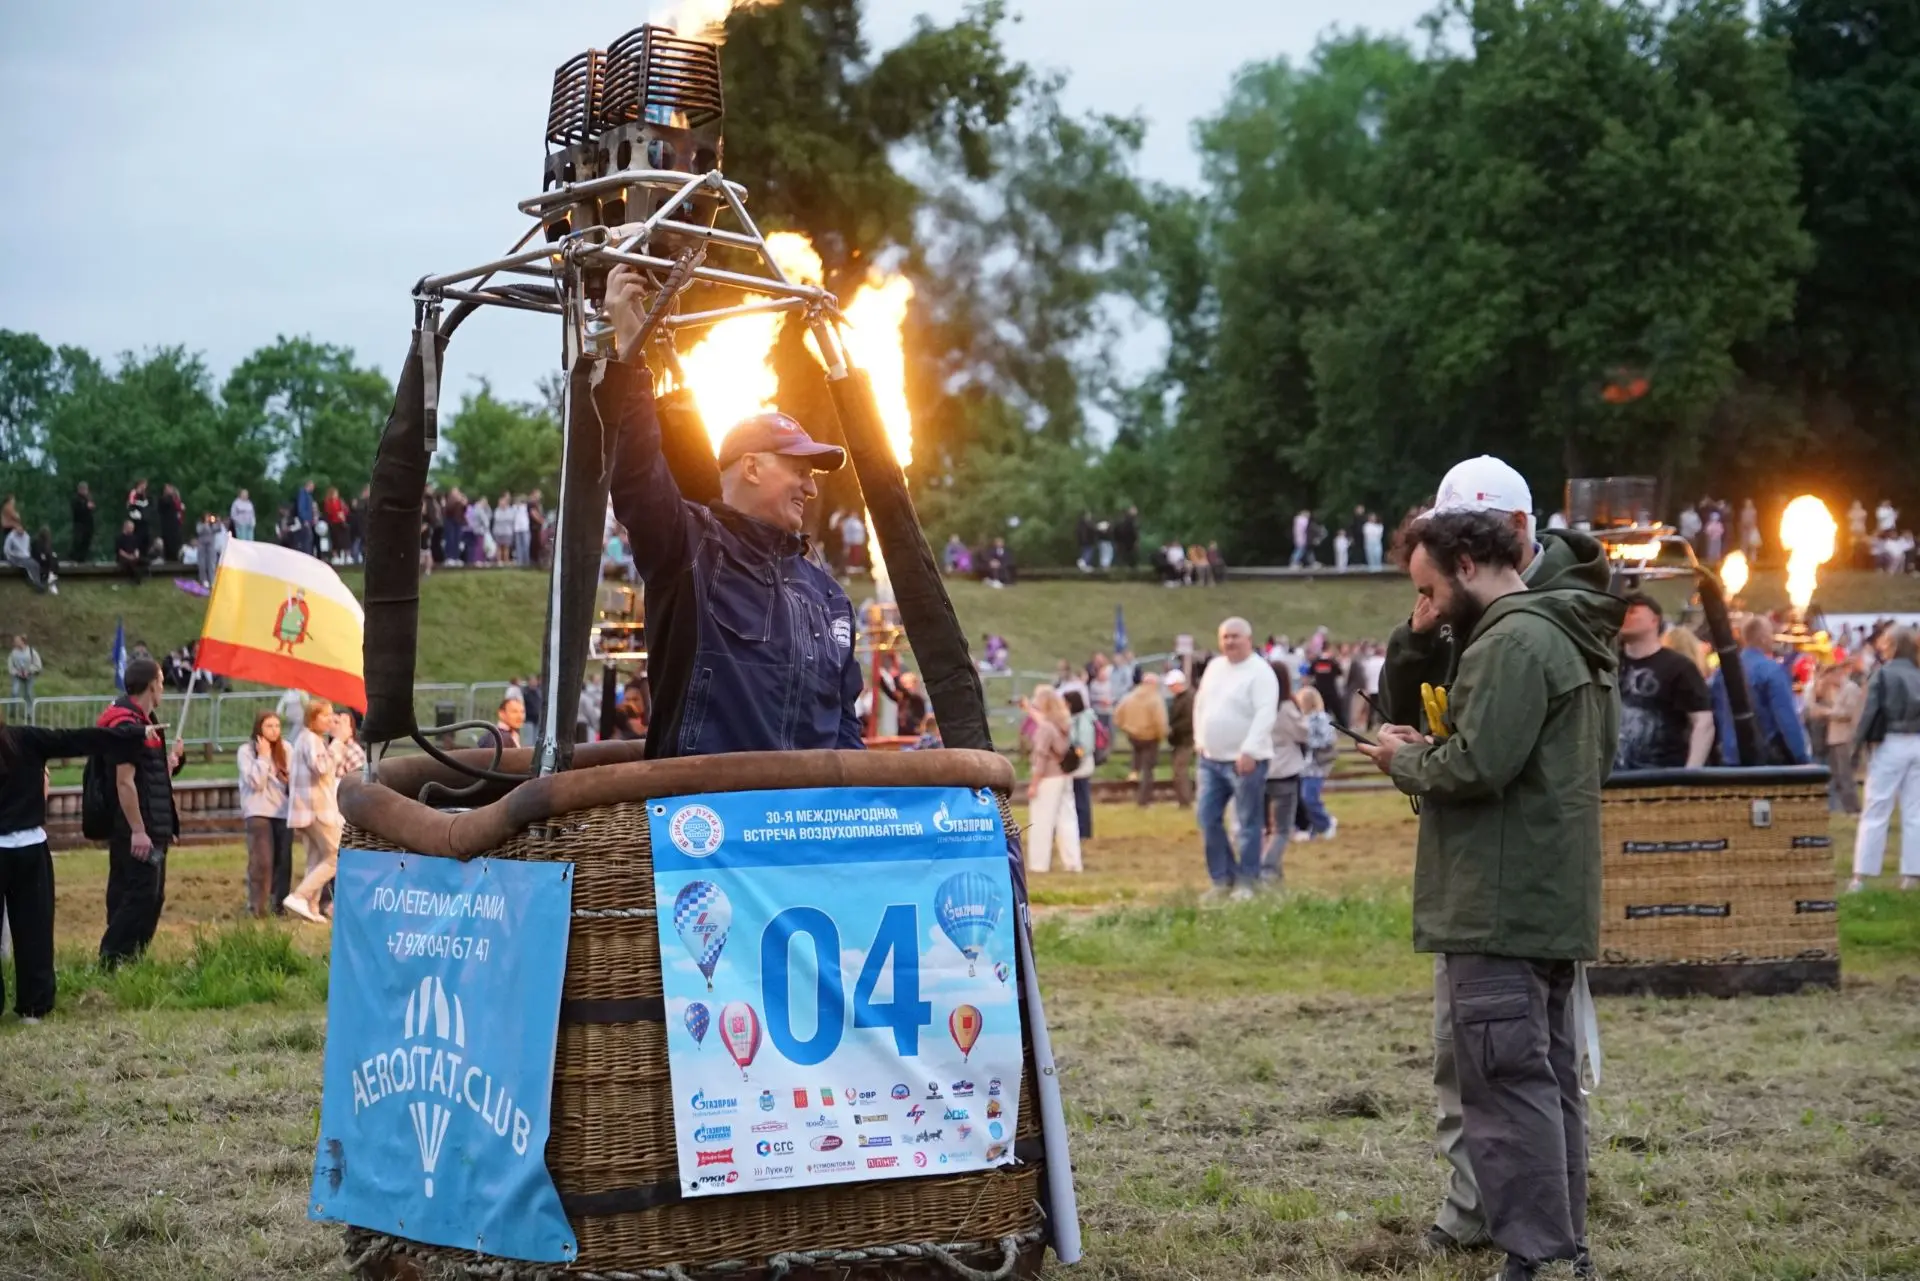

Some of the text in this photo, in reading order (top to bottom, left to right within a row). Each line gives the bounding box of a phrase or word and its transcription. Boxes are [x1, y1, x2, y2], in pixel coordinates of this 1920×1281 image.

[766, 807, 898, 824] 30-Я МЕЖДУНАРОДНАЯ
[953, 818, 994, 832] ГАЗПРОМ
[674, 808, 692, 848] ВЕЛИКИЕ
[695, 807, 719, 826] ЛУКИ
[743, 820, 924, 842] ВСТРЕЧА ВОЗДУХОПЛАВАТЕЛЕЙ
[373, 887, 449, 917] ПОЛЕТЕЛИ
[461, 893, 504, 920] НАМИ
[387, 932, 490, 961] +7 978 047 67 47
[760, 905, 932, 1066] 04
[352, 1045, 531, 1156] AEROSTAT.CLUB
[706, 1098, 737, 1109] ГАЗПРОМ
[773, 1141, 794, 1151] СГС
[699, 1174, 725, 1183] ЛУКИ
